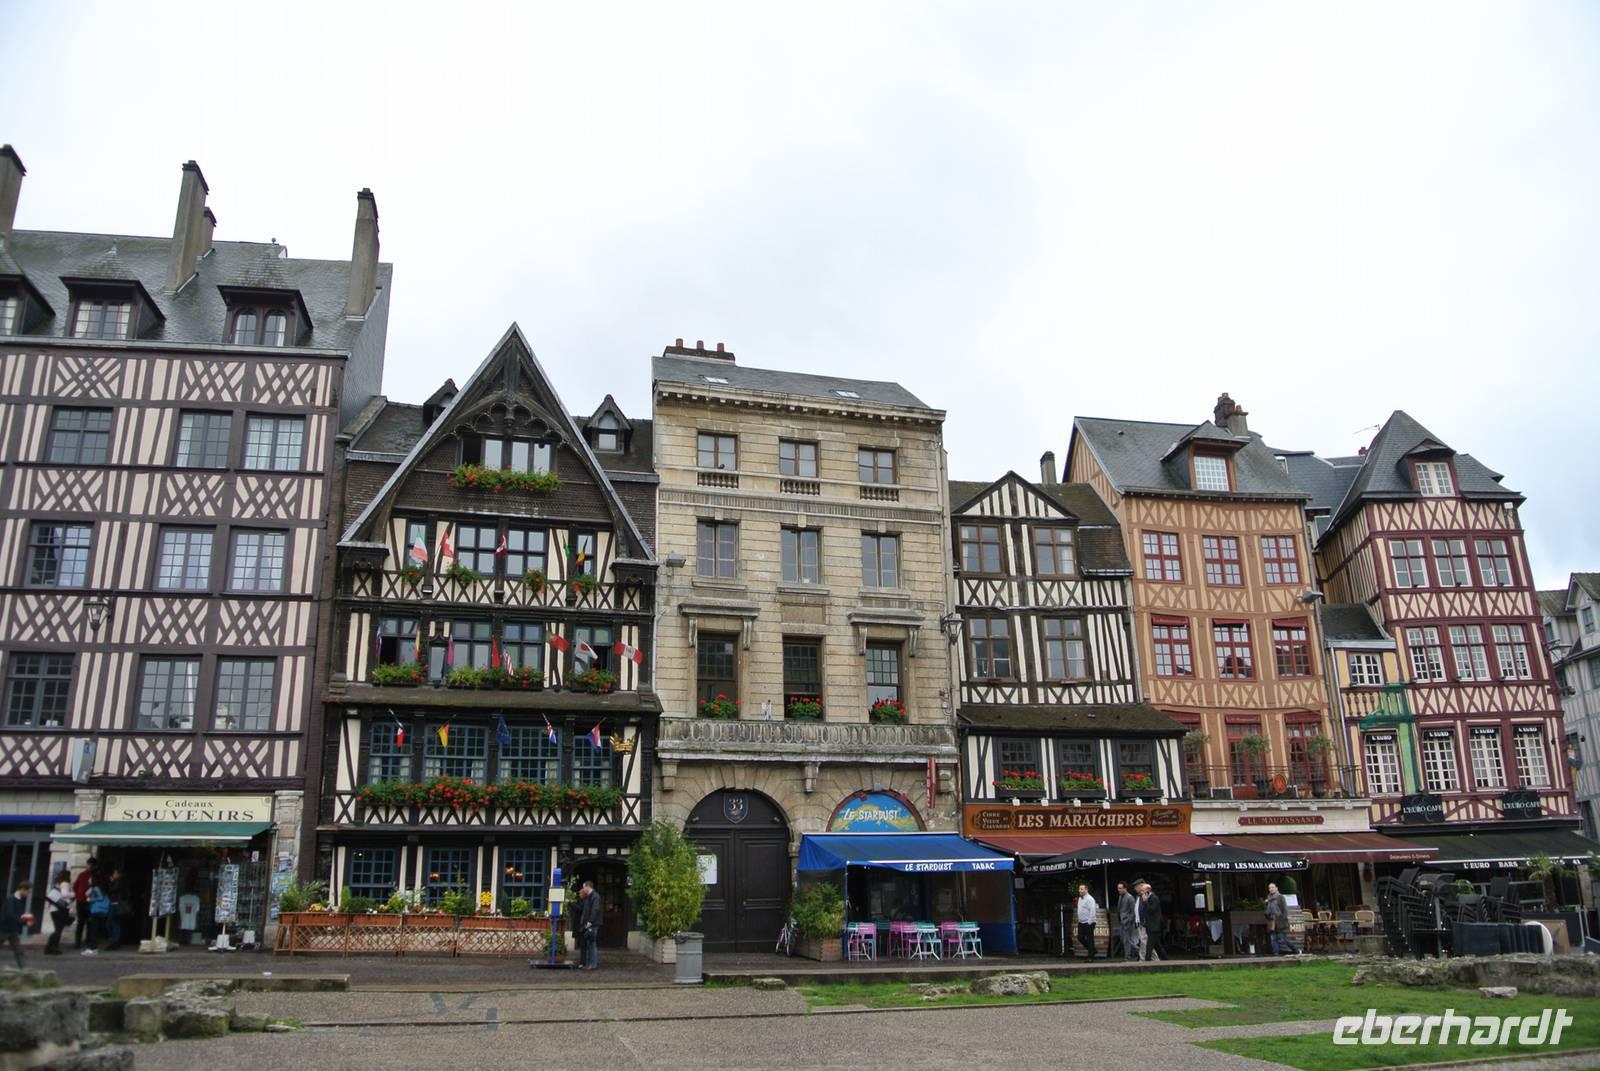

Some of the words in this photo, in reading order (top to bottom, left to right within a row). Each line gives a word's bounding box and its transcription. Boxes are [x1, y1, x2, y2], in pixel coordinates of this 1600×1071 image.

[165, 799, 214, 808] Cadeaux
[729, 799, 743, 810] 33
[122, 809, 254, 821] SOUVENIRS
[858, 809, 898, 821] STARDUST
[1018, 814, 1044, 828] LES
[1049, 813, 1145, 828] MARAICHERS
[1261, 816, 1316, 825] MAUPASSANT
[916, 862, 953, 871] STARDUST
[972, 862, 995, 870] TABAC
[1197, 861, 1216, 870] Depuis
[1234, 862, 1248, 870] LES
[1248, 861, 1293, 869] MARAICHERS
